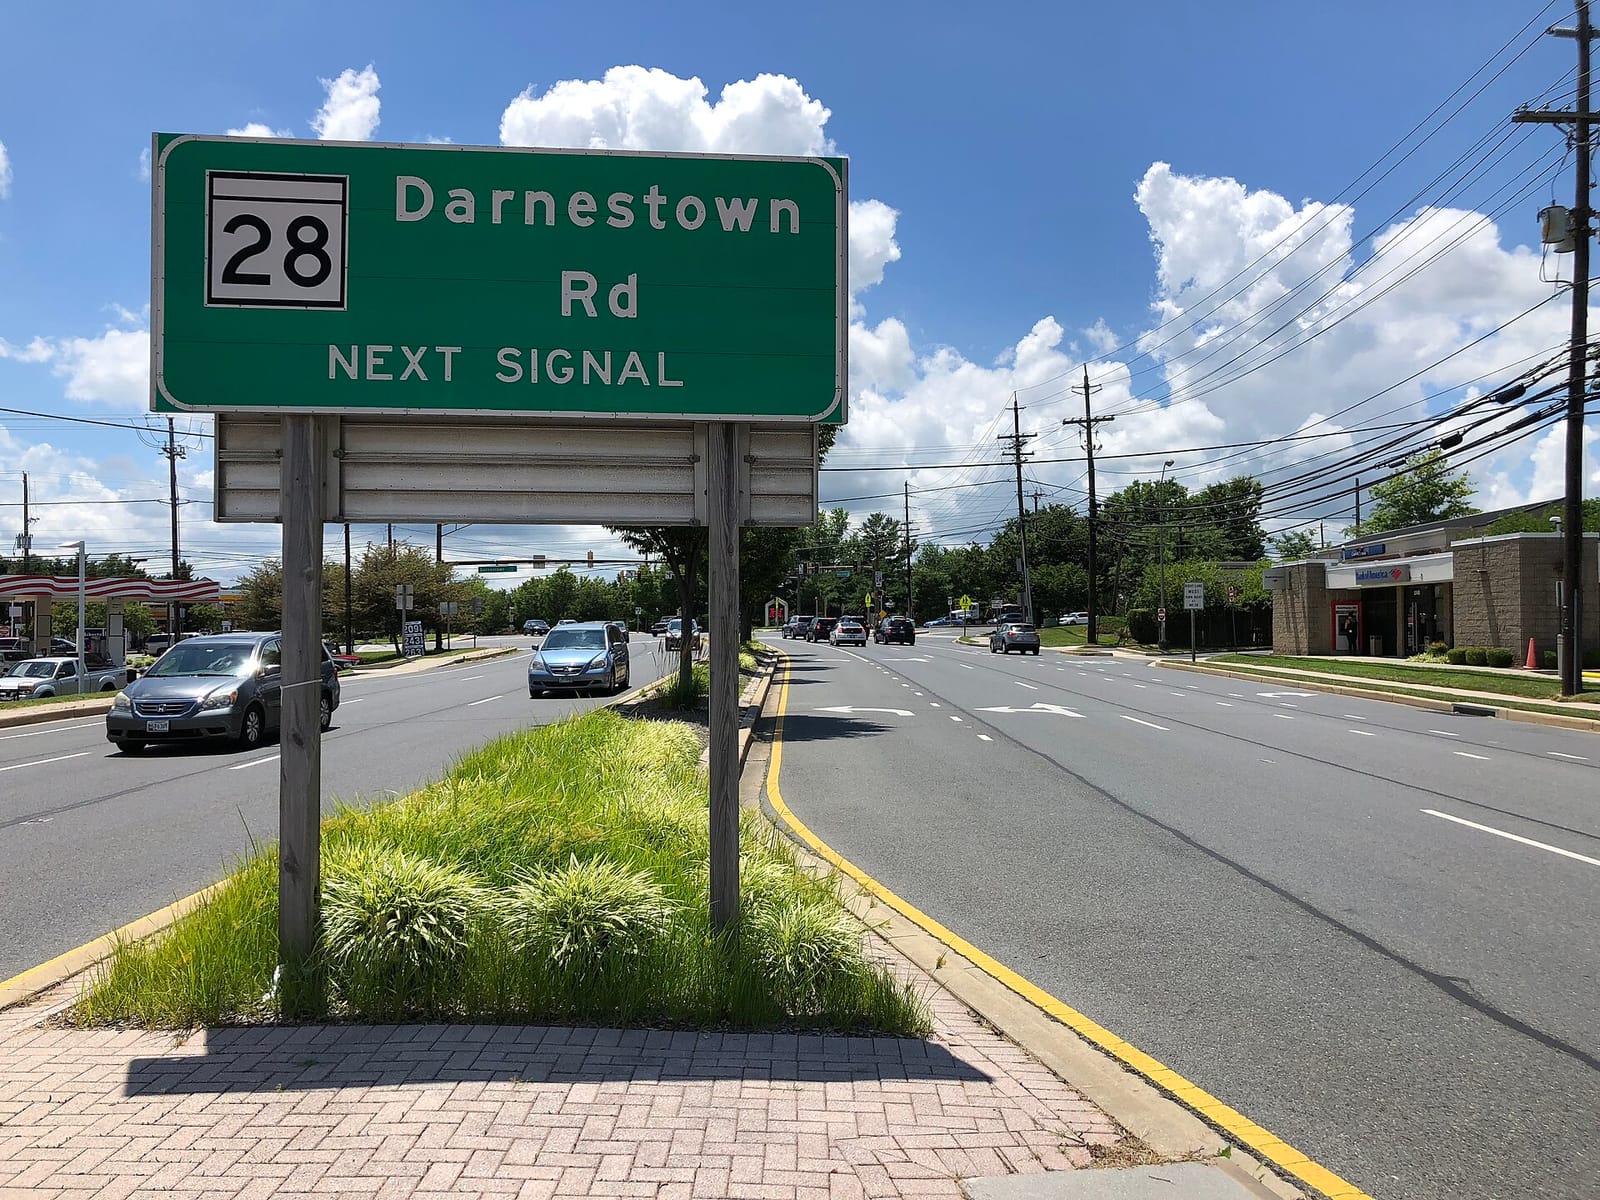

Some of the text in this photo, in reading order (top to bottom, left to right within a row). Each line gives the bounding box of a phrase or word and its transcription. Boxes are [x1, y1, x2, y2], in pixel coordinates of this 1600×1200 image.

[395, 174, 800, 235] Darnestown
[221, 213, 333, 288] 28
[561, 270, 638, 319] Rd
[327, 344, 685, 388] NEXT SIGNAL
